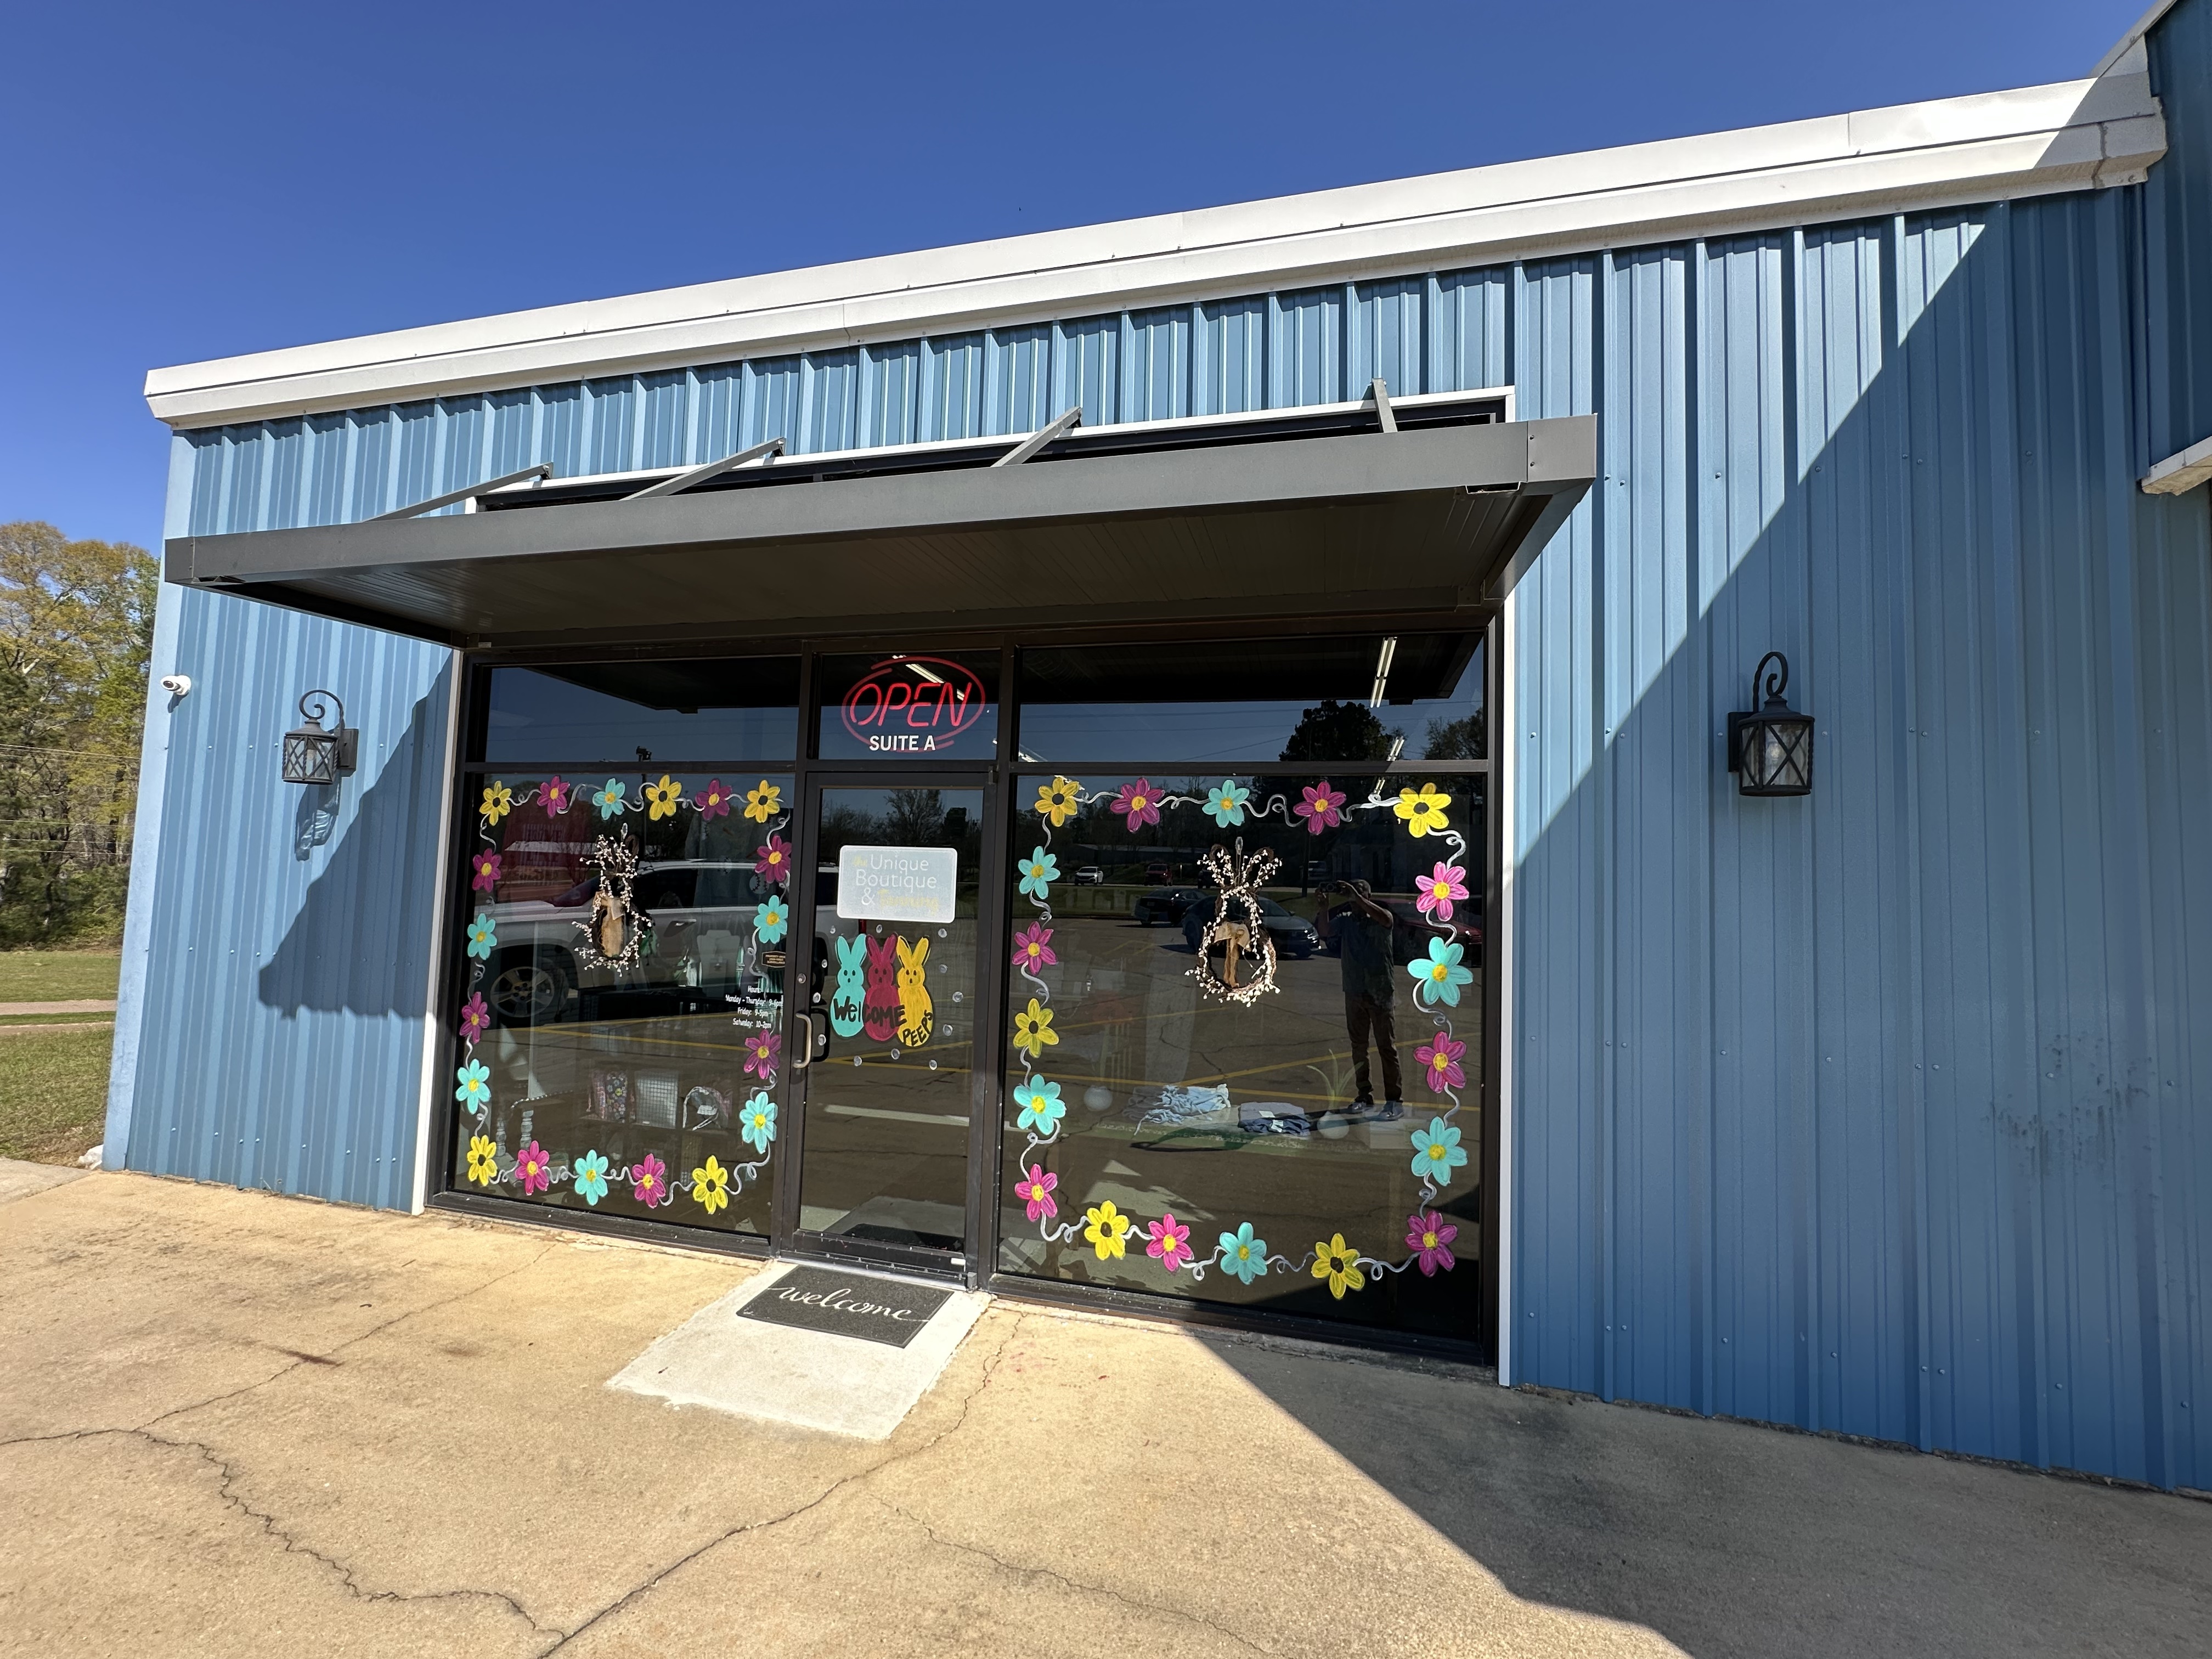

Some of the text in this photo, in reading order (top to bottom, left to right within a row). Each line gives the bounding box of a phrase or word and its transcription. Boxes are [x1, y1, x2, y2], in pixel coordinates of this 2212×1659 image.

[850, 682, 972, 727] OPEN
[869, 735, 936, 751] SUITE A
[870, 853, 929, 876] Unique
[856, 868, 937, 893] Boutique
[861, 887, 874, 905] &
[725, 994, 741, 1005] Monday
[768, 1287, 929, 1322] welcome
